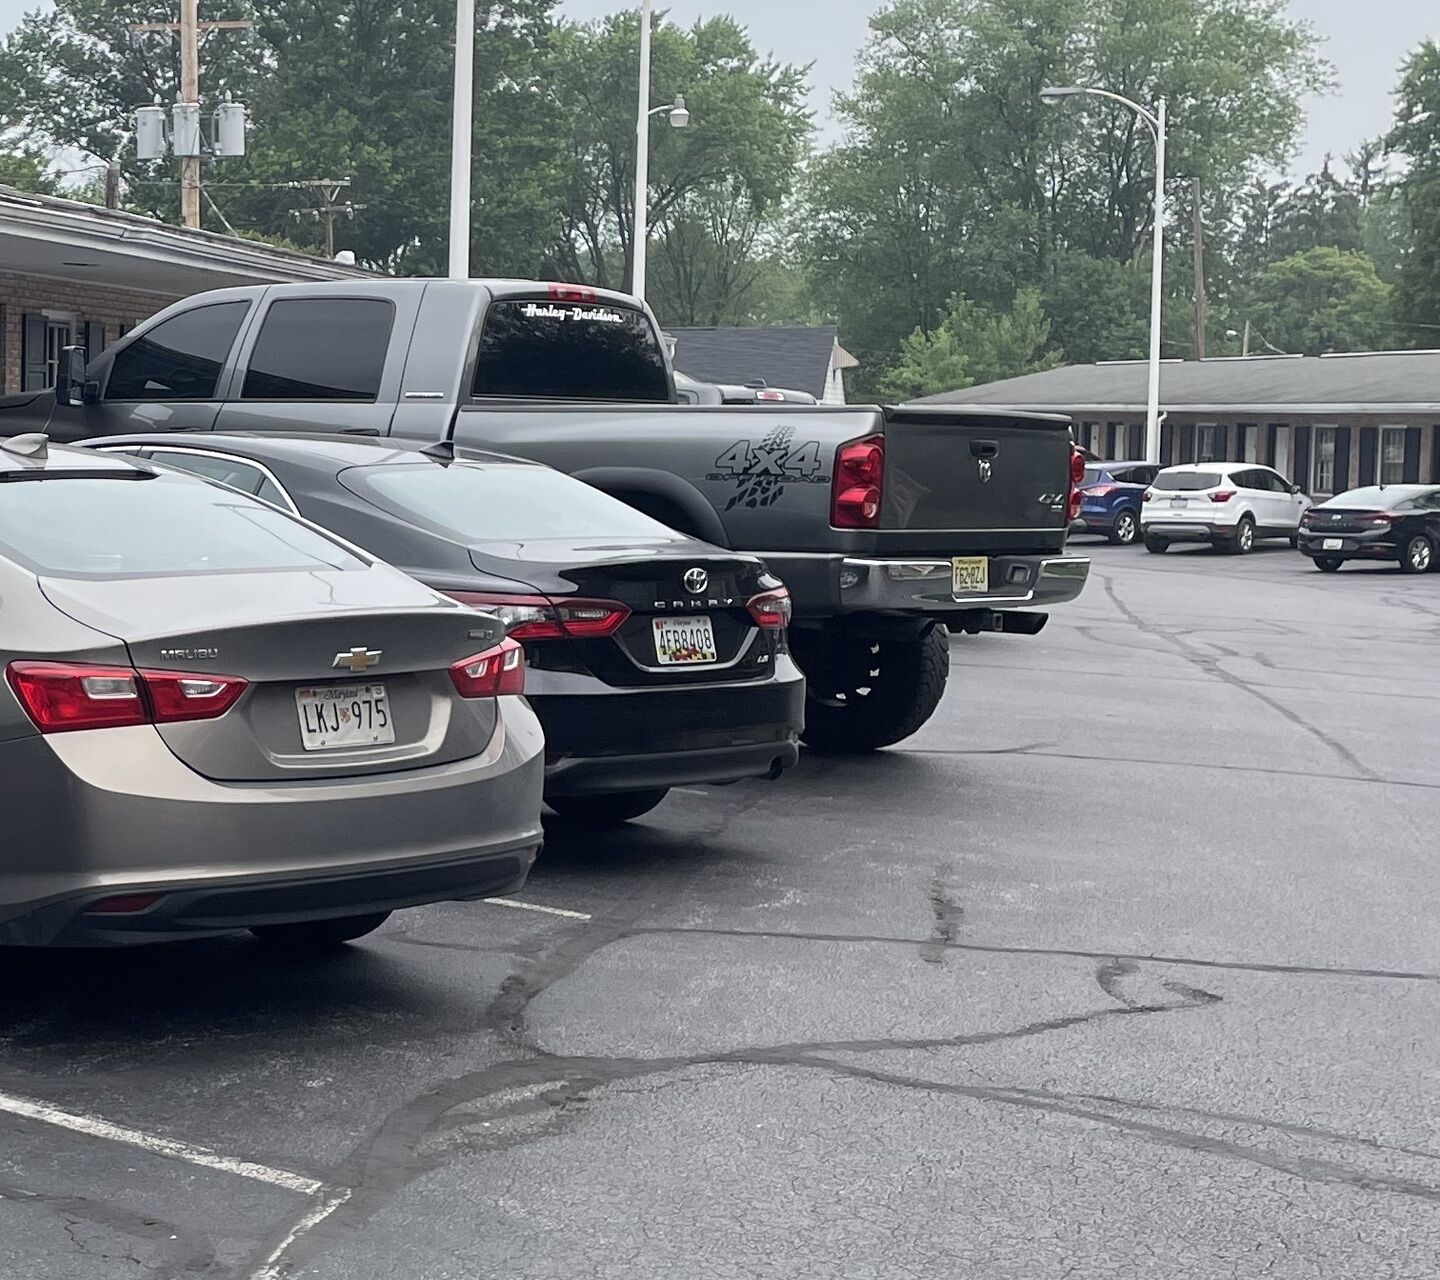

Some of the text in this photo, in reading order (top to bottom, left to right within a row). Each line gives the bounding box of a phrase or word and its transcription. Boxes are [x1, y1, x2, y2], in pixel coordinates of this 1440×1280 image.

[521, 303, 623, 323] Harley-Davidson
[654, 598, 734, 609] CAMRY
[160, 648, 218, 660] MALIBU
